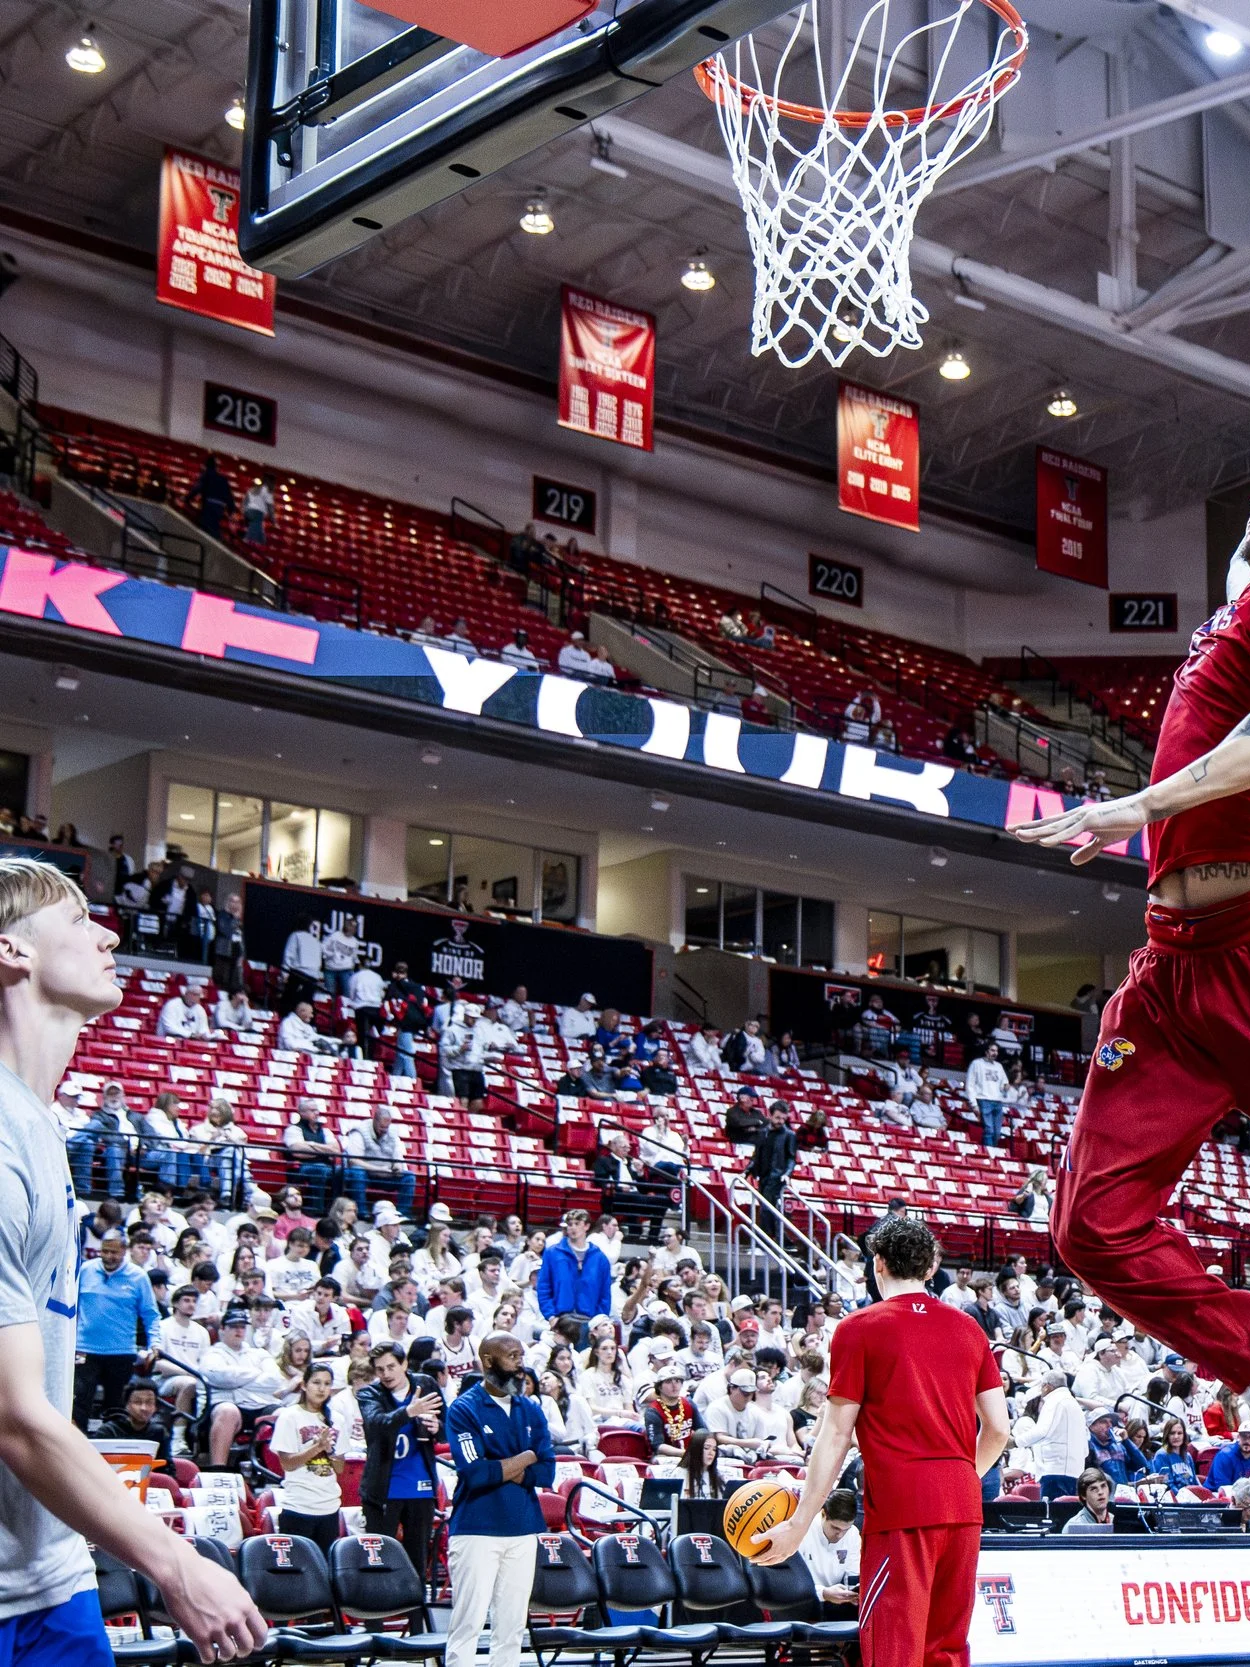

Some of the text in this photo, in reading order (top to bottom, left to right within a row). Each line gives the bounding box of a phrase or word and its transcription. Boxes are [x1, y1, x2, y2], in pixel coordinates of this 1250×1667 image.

[214, 395, 262, 433] 218
[853, 446, 878, 464] ELITE
[545, 488, 584, 522] 219
[1050, 508, 1073, 524] FINAL
[815, 563, 859, 598] 220
[1123, 600, 1165, 627] 221
[432, 951, 484, 980] HONOR
